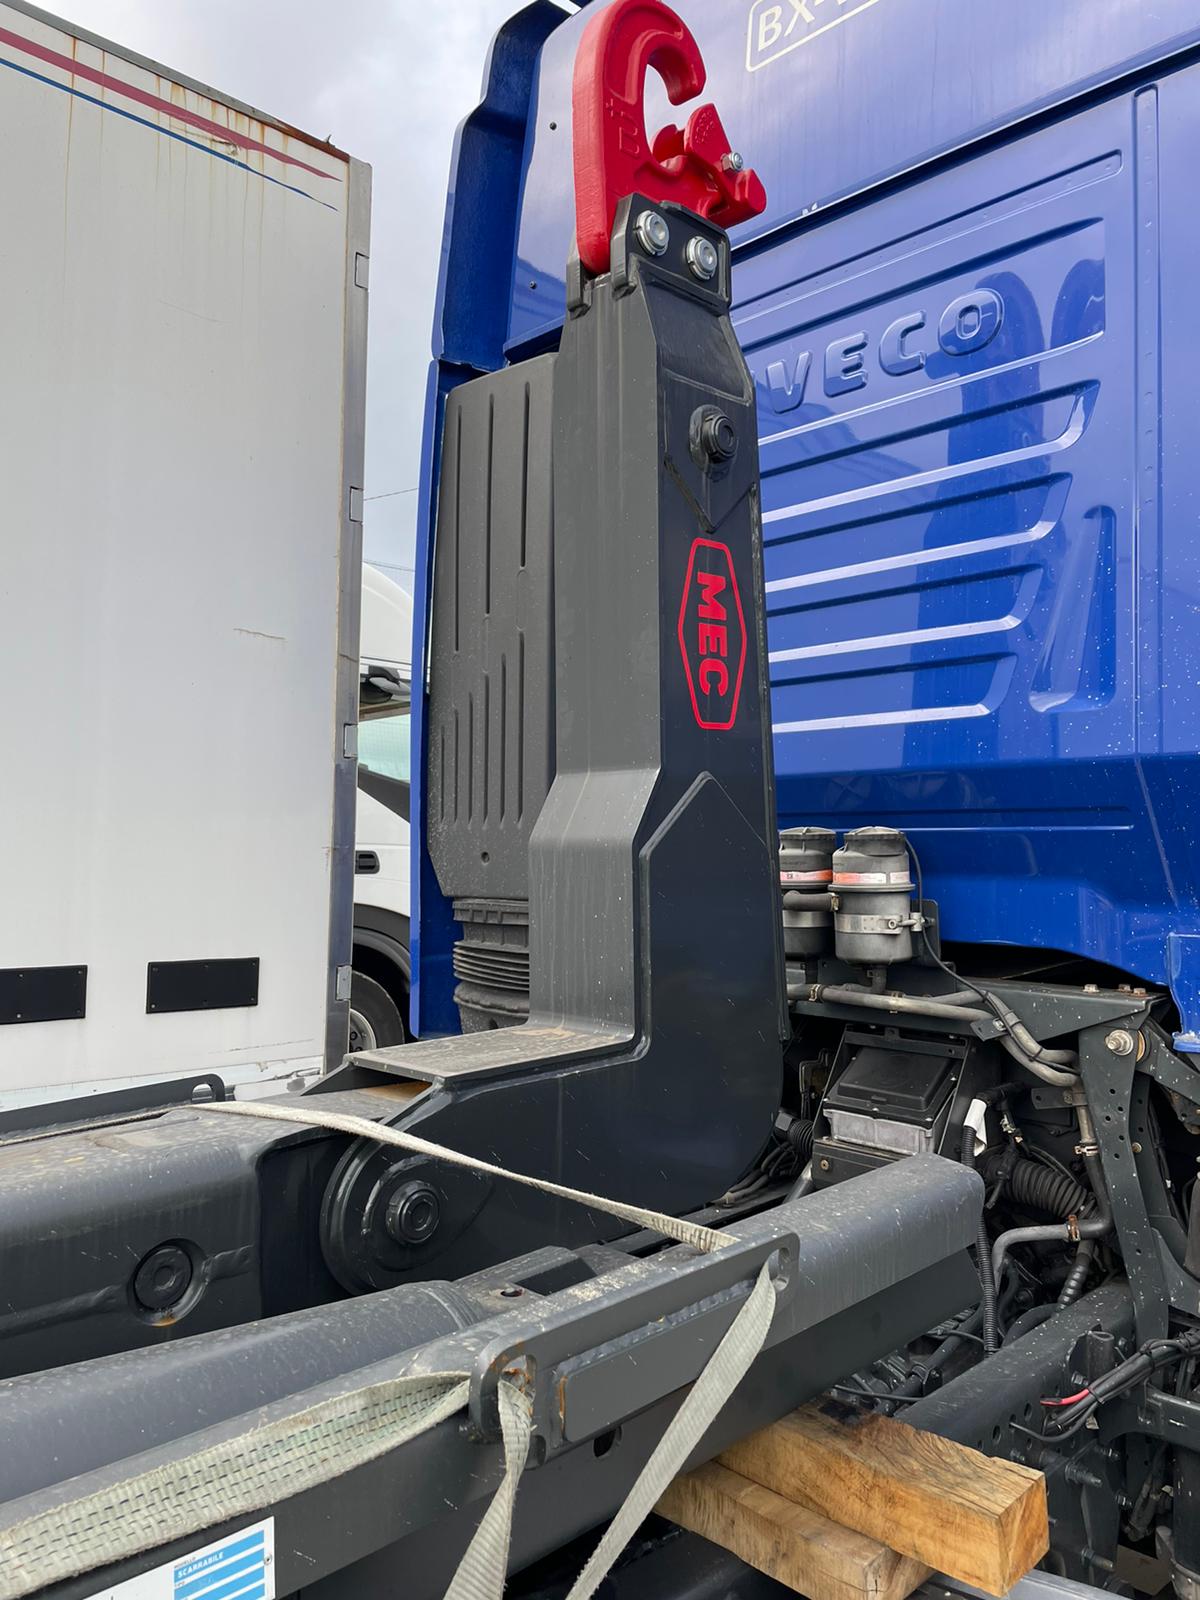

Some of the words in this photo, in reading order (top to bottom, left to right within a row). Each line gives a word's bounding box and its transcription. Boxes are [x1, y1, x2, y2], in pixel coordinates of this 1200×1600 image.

[752, 288, 1005, 414] VECO
[697, 571, 729, 697] MEC
[177, 1551, 224, 1578] SCARRABILE
